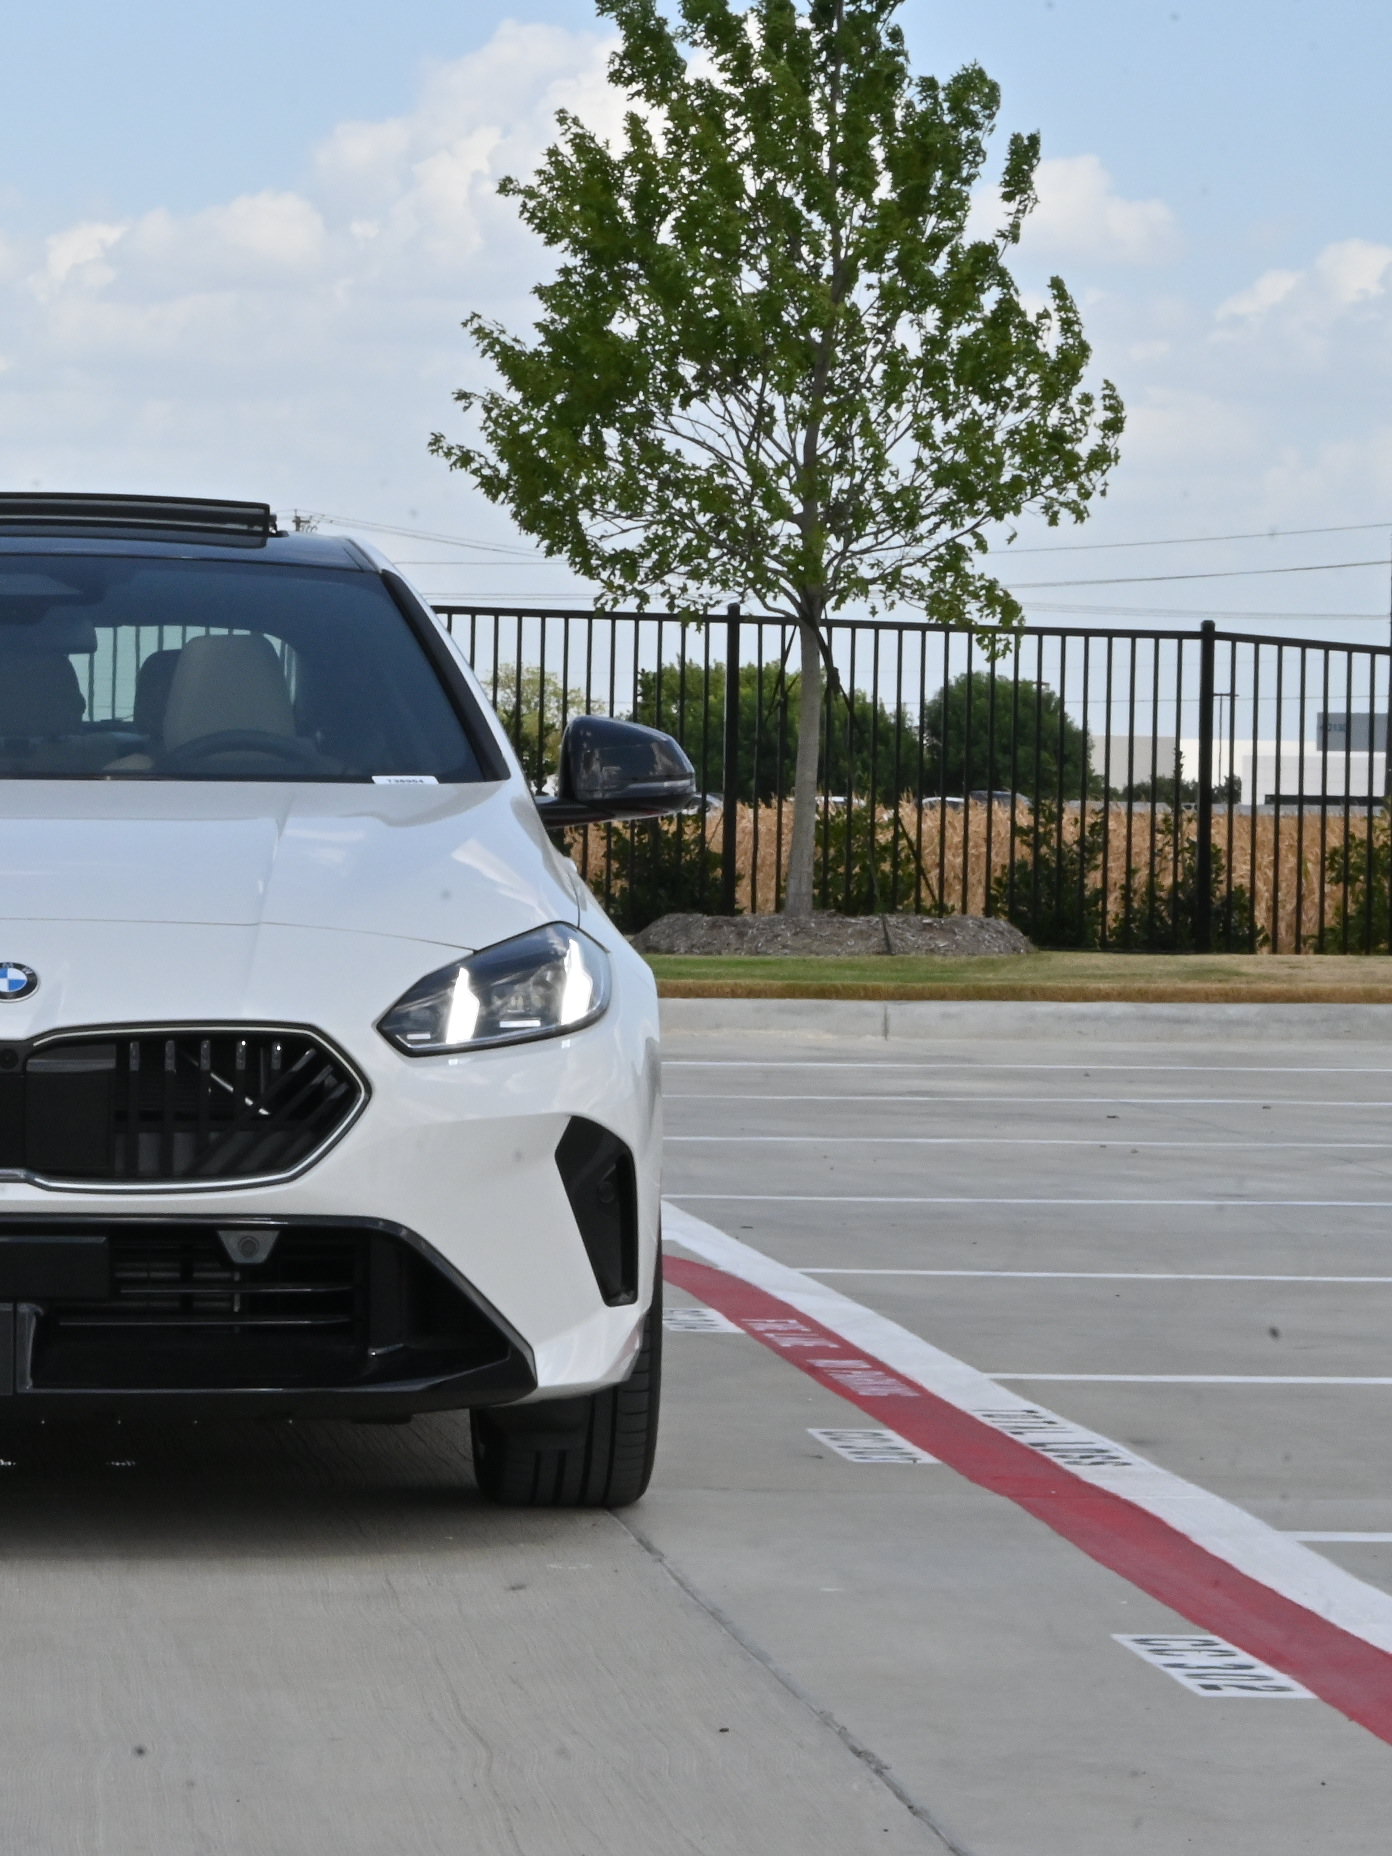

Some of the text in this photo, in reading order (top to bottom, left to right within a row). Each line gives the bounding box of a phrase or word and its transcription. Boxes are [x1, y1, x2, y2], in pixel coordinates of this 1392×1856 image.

[1028, 1441, 1132, 1466] LOSS
[1131, 1638, 1295, 1691] CC 302
